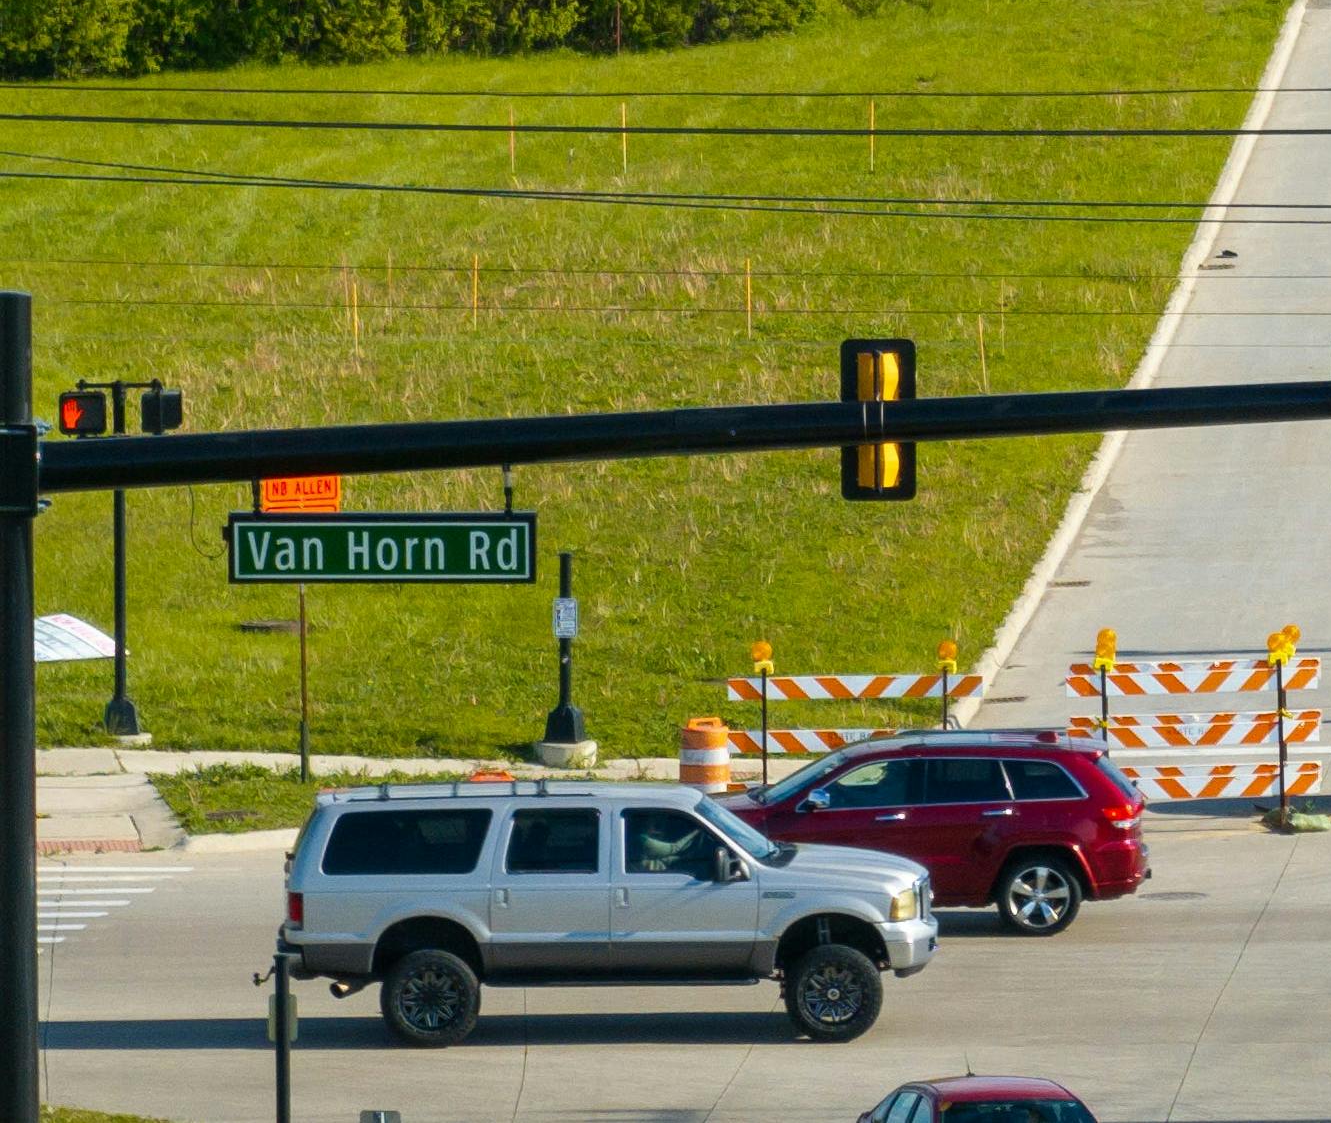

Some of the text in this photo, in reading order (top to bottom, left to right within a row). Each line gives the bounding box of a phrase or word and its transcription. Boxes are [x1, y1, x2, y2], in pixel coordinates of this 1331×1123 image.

[271, 478, 332, 495] NB ALLEN
[247, 527, 518, 571] Van Horn Rd
